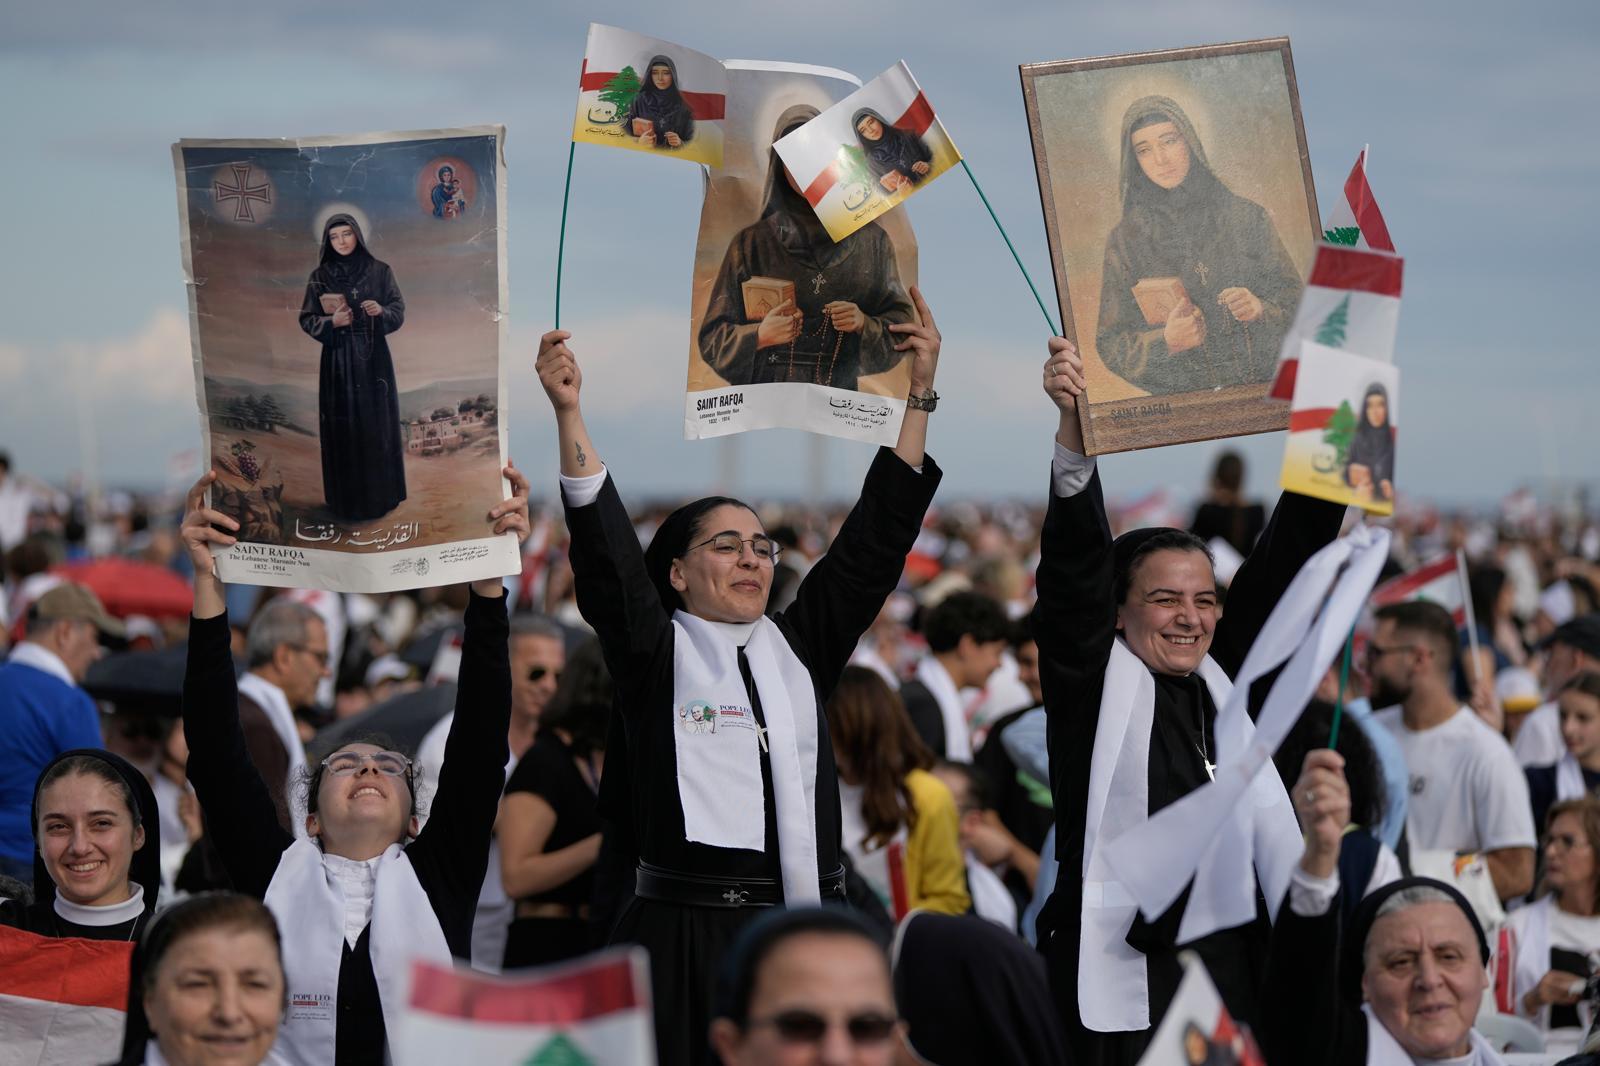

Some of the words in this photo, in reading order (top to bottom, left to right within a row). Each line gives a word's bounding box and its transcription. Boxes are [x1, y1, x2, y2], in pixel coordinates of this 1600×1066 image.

[697, 396, 718, 411] SAINT
[719, 392, 744, 407] RAFQA
[234, 544, 266, 555] SAINT
[268, 547, 305, 559] RAFQA
[241, 555, 269, 563] Lebanese
[270, 558, 296, 566] Maronite
